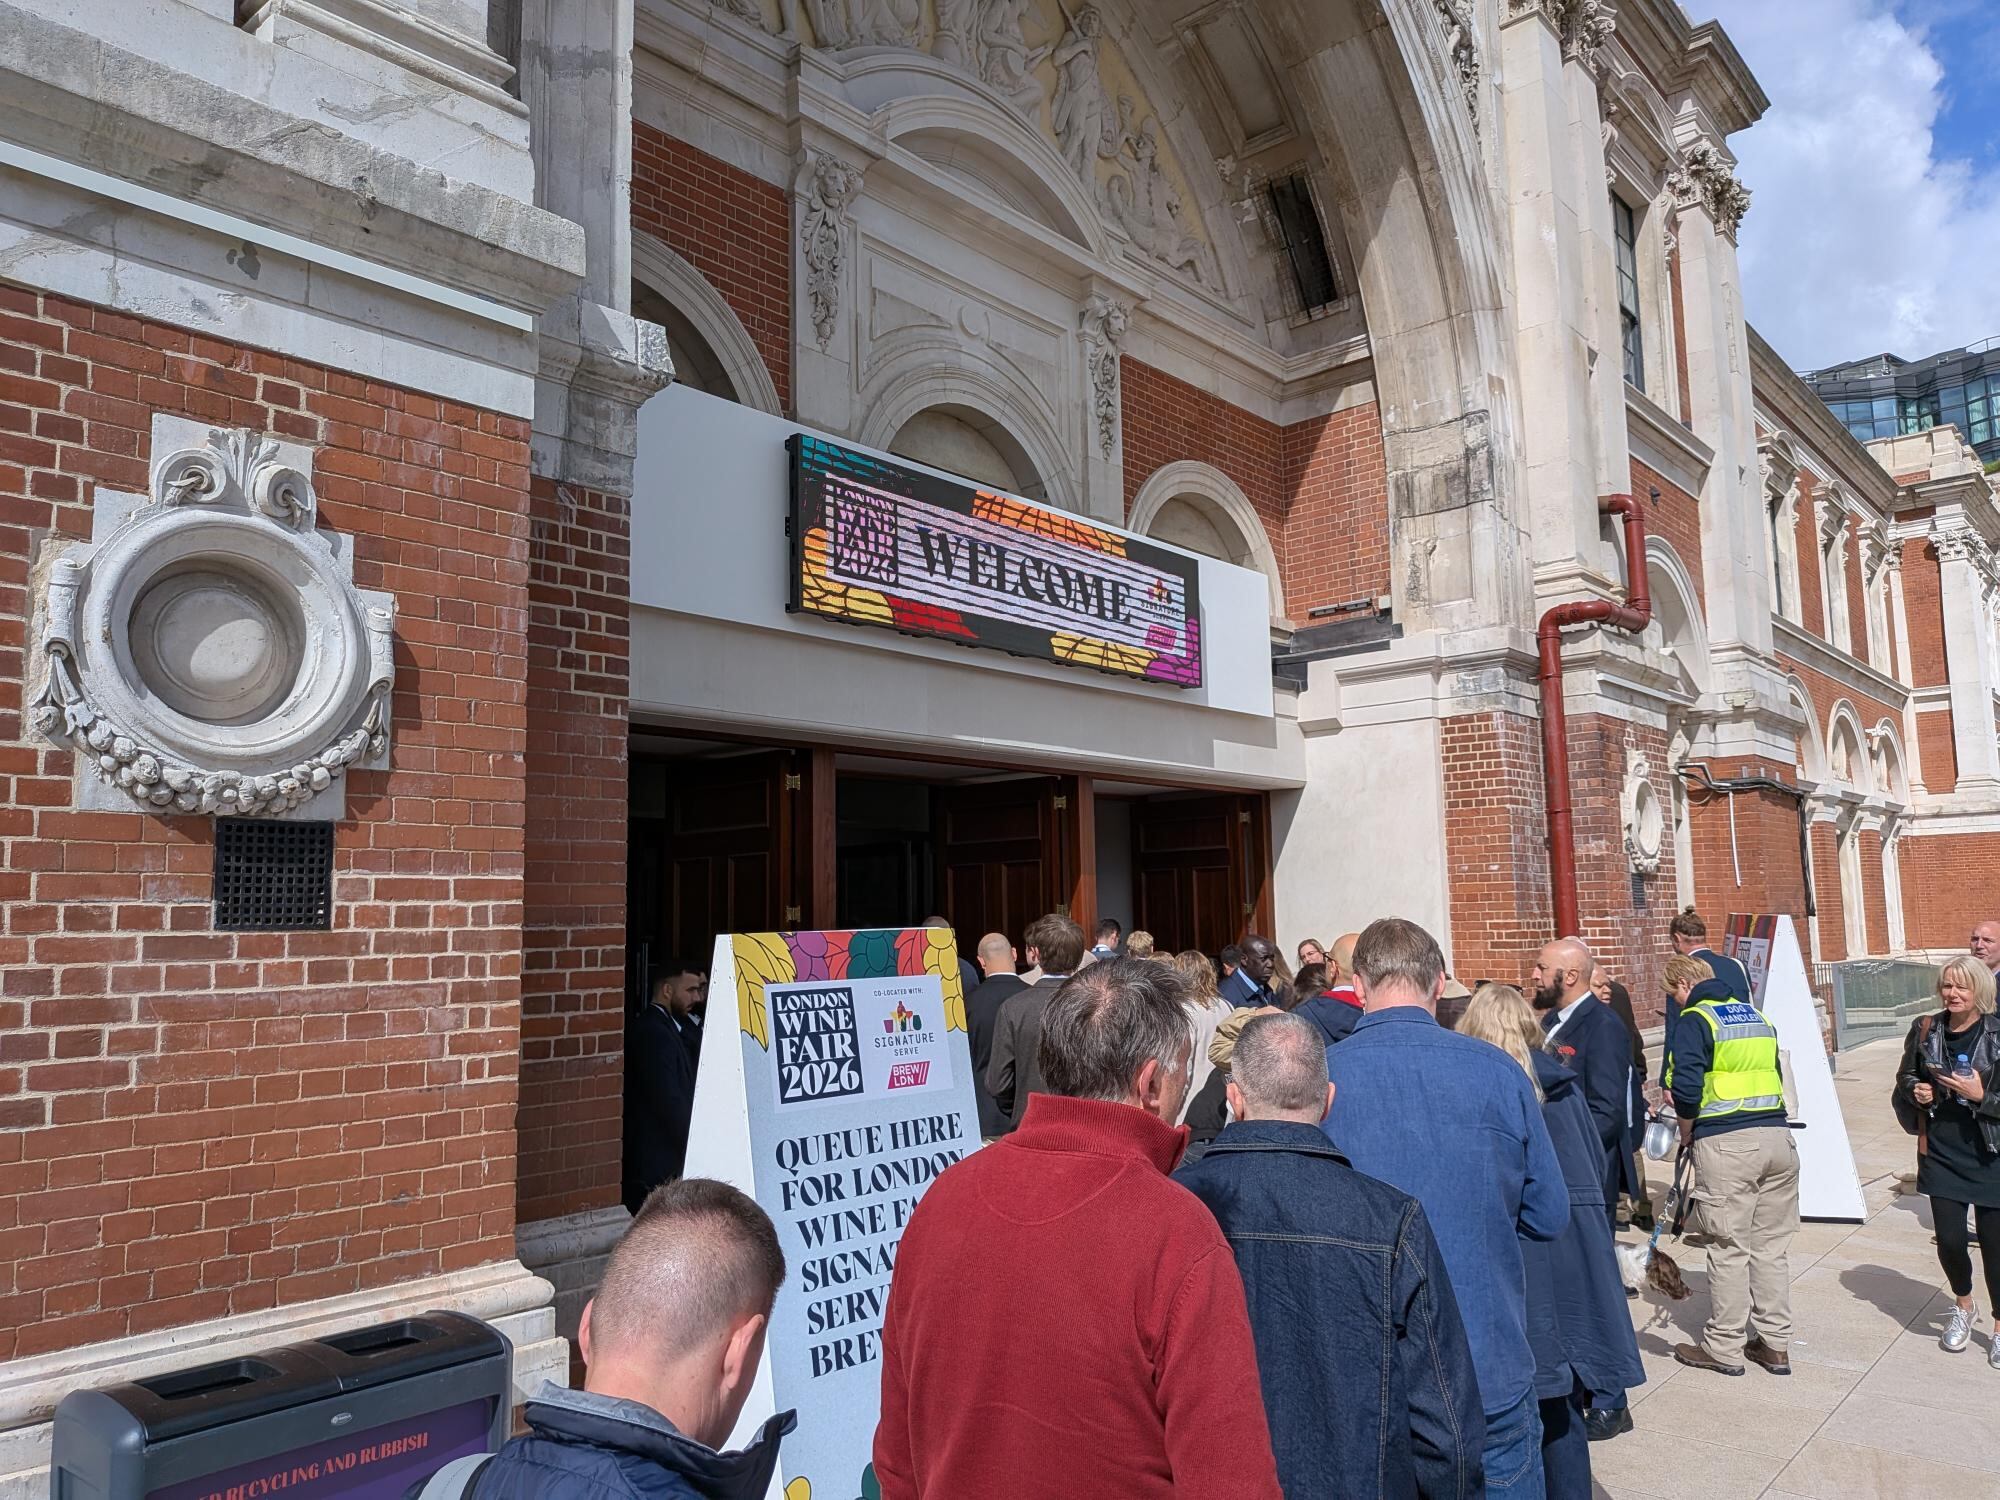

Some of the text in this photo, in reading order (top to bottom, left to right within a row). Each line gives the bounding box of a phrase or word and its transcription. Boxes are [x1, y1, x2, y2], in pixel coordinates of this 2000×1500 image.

[836, 487, 895, 512] LONDON
[836, 498, 896, 535] WINE
[836, 521, 895, 558] FAIR
[836, 545, 897, 583] 2026
[915, 525, 1131, 624] WELCOME
[776, 991, 850, 1012] LONDON
[873, 988, 907, 997] CO-LOCATED
[1726, 1004, 1747, 1014] DOG
[777, 1007, 853, 1036] WINE
[1720, 1013, 1762, 1024] HANDLER
[779, 1032, 856, 1065] FAIR
[874, 1032, 935, 1048] SIGNATURE
[894, 1046, 920, 1056] SERVE
[781, 1058, 860, 1099] 2026
[892, 1064, 920, 1077] BREW
[893, 1074, 915, 1087] LDN
[775, 1112, 964, 1177] QUEUE HERE
[780, 1172, 848, 1212] FOR
[795, 1203, 887, 1250] WINE
[801, 1240, 900, 1293] SIGNA
[807, 1284, 891, 1335] SERV
[808, 1328, 883, 1379] BRE
[225, 1431, 429, 1500] RECYCLING AND RUBBISH
